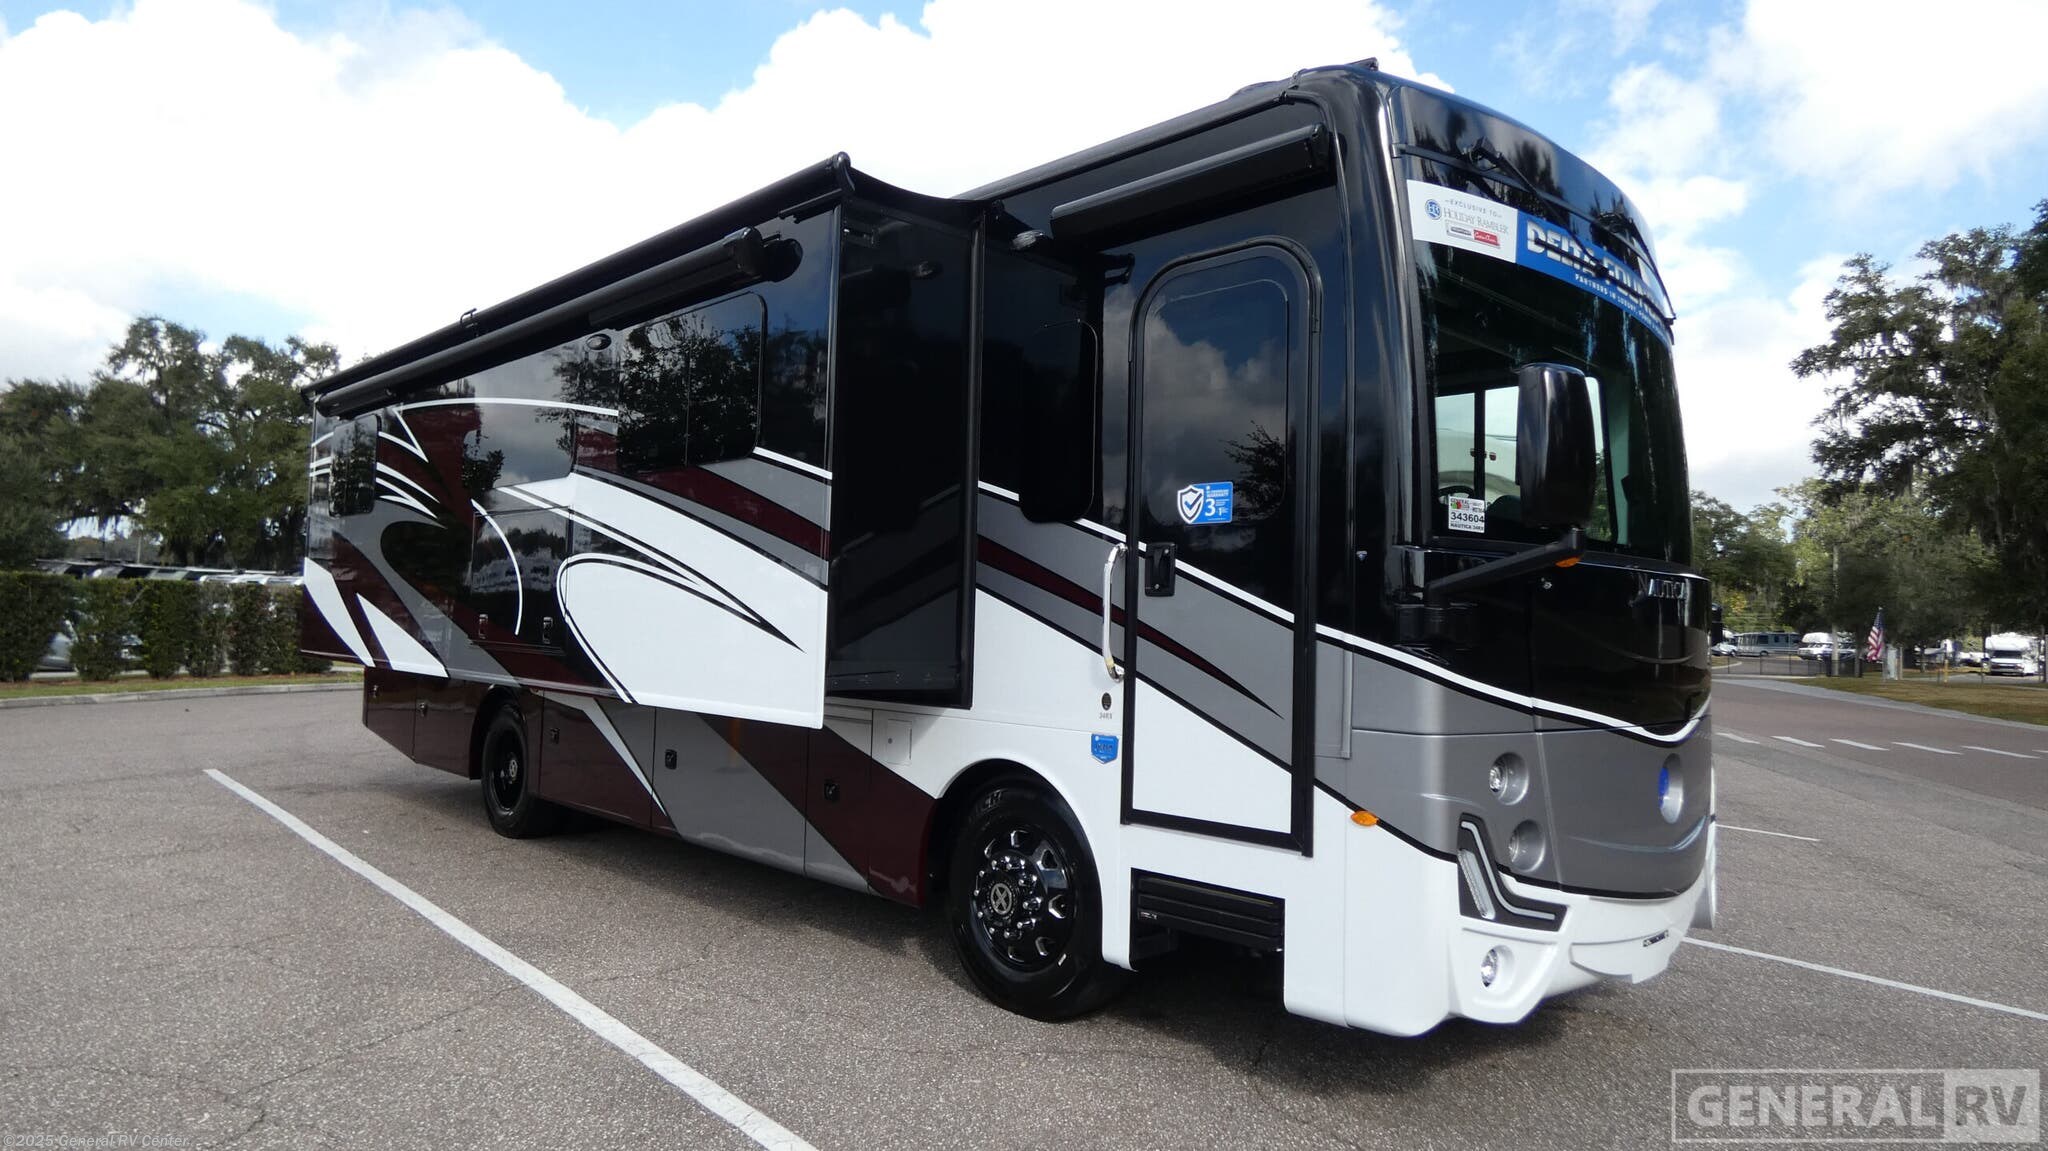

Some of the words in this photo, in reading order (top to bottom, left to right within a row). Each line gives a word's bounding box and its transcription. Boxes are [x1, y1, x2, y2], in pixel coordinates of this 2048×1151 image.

[1443, 207, 1475, 224] HOLIDAY
[1477, 216, 1508, 234] RAMBLER
[1204, 498, 1216, 517] 3
[1450, 512, 1485, 523] 343604
